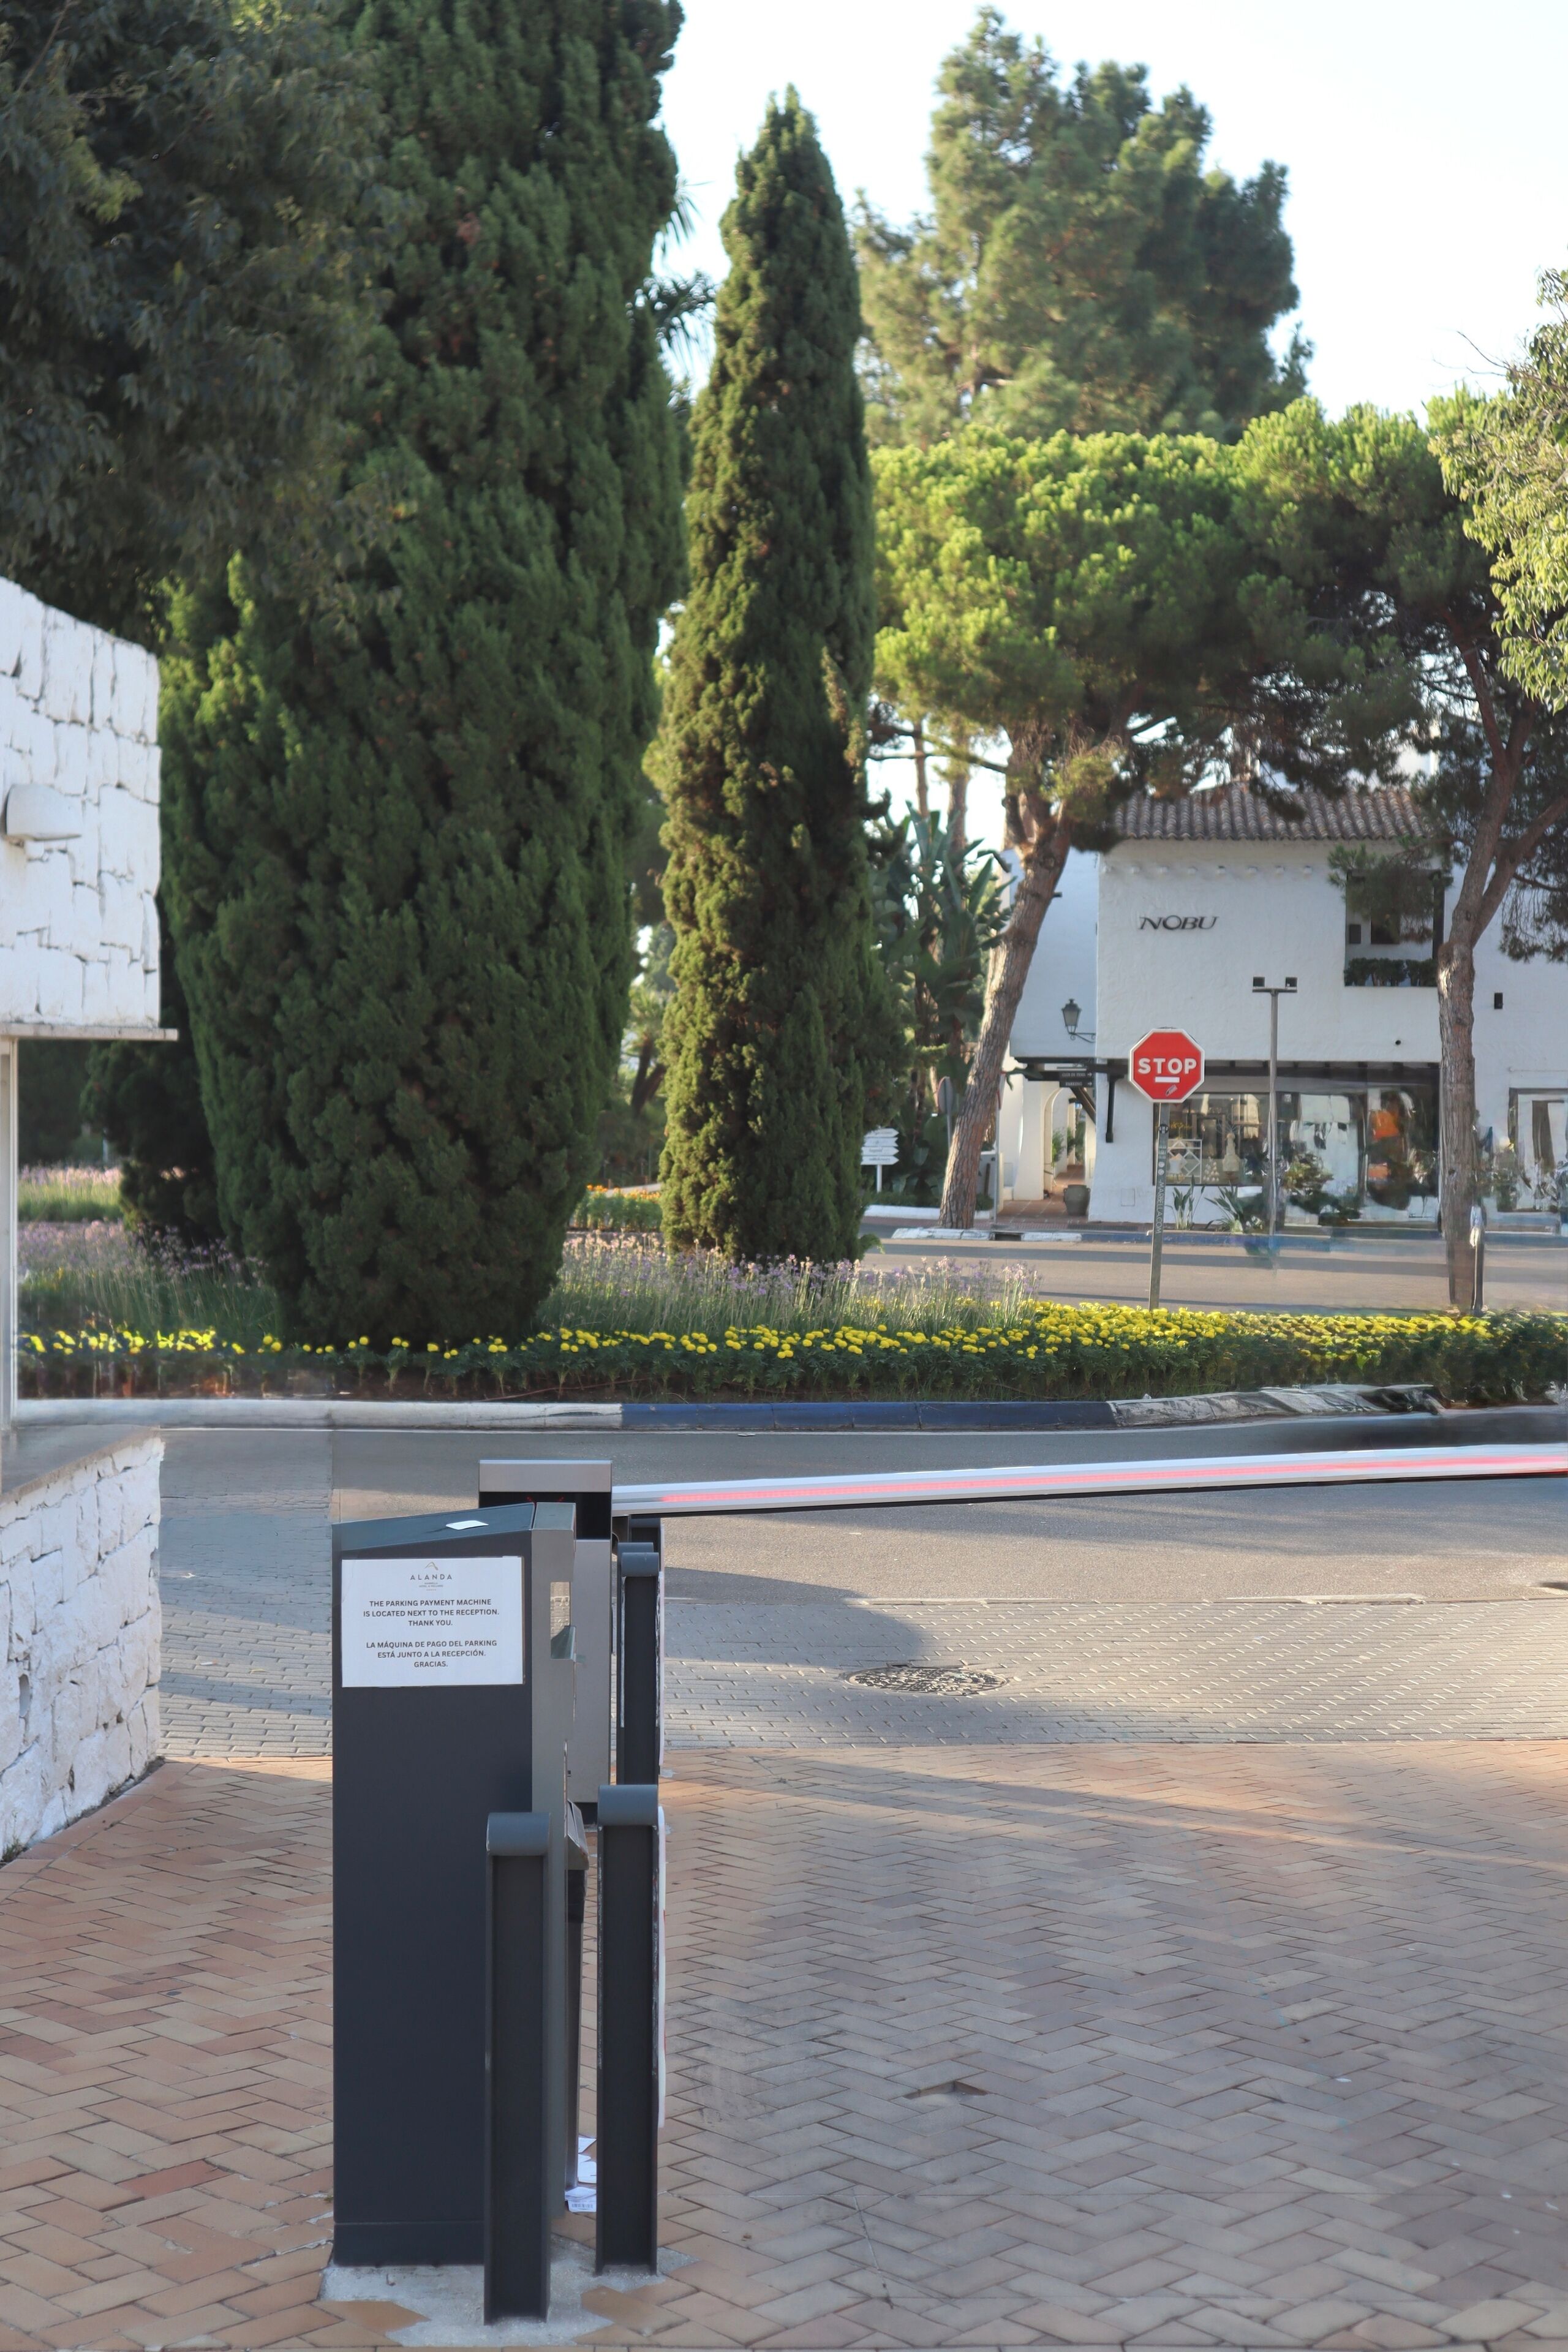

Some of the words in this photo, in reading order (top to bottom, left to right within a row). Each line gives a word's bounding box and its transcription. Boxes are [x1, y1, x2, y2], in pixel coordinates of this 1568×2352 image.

[1139, 914, 1219, 930] NOBU
[1138, 1058, 1197, 1074] STOP
[377, 1640, 413, 1649] MÁQUINA
